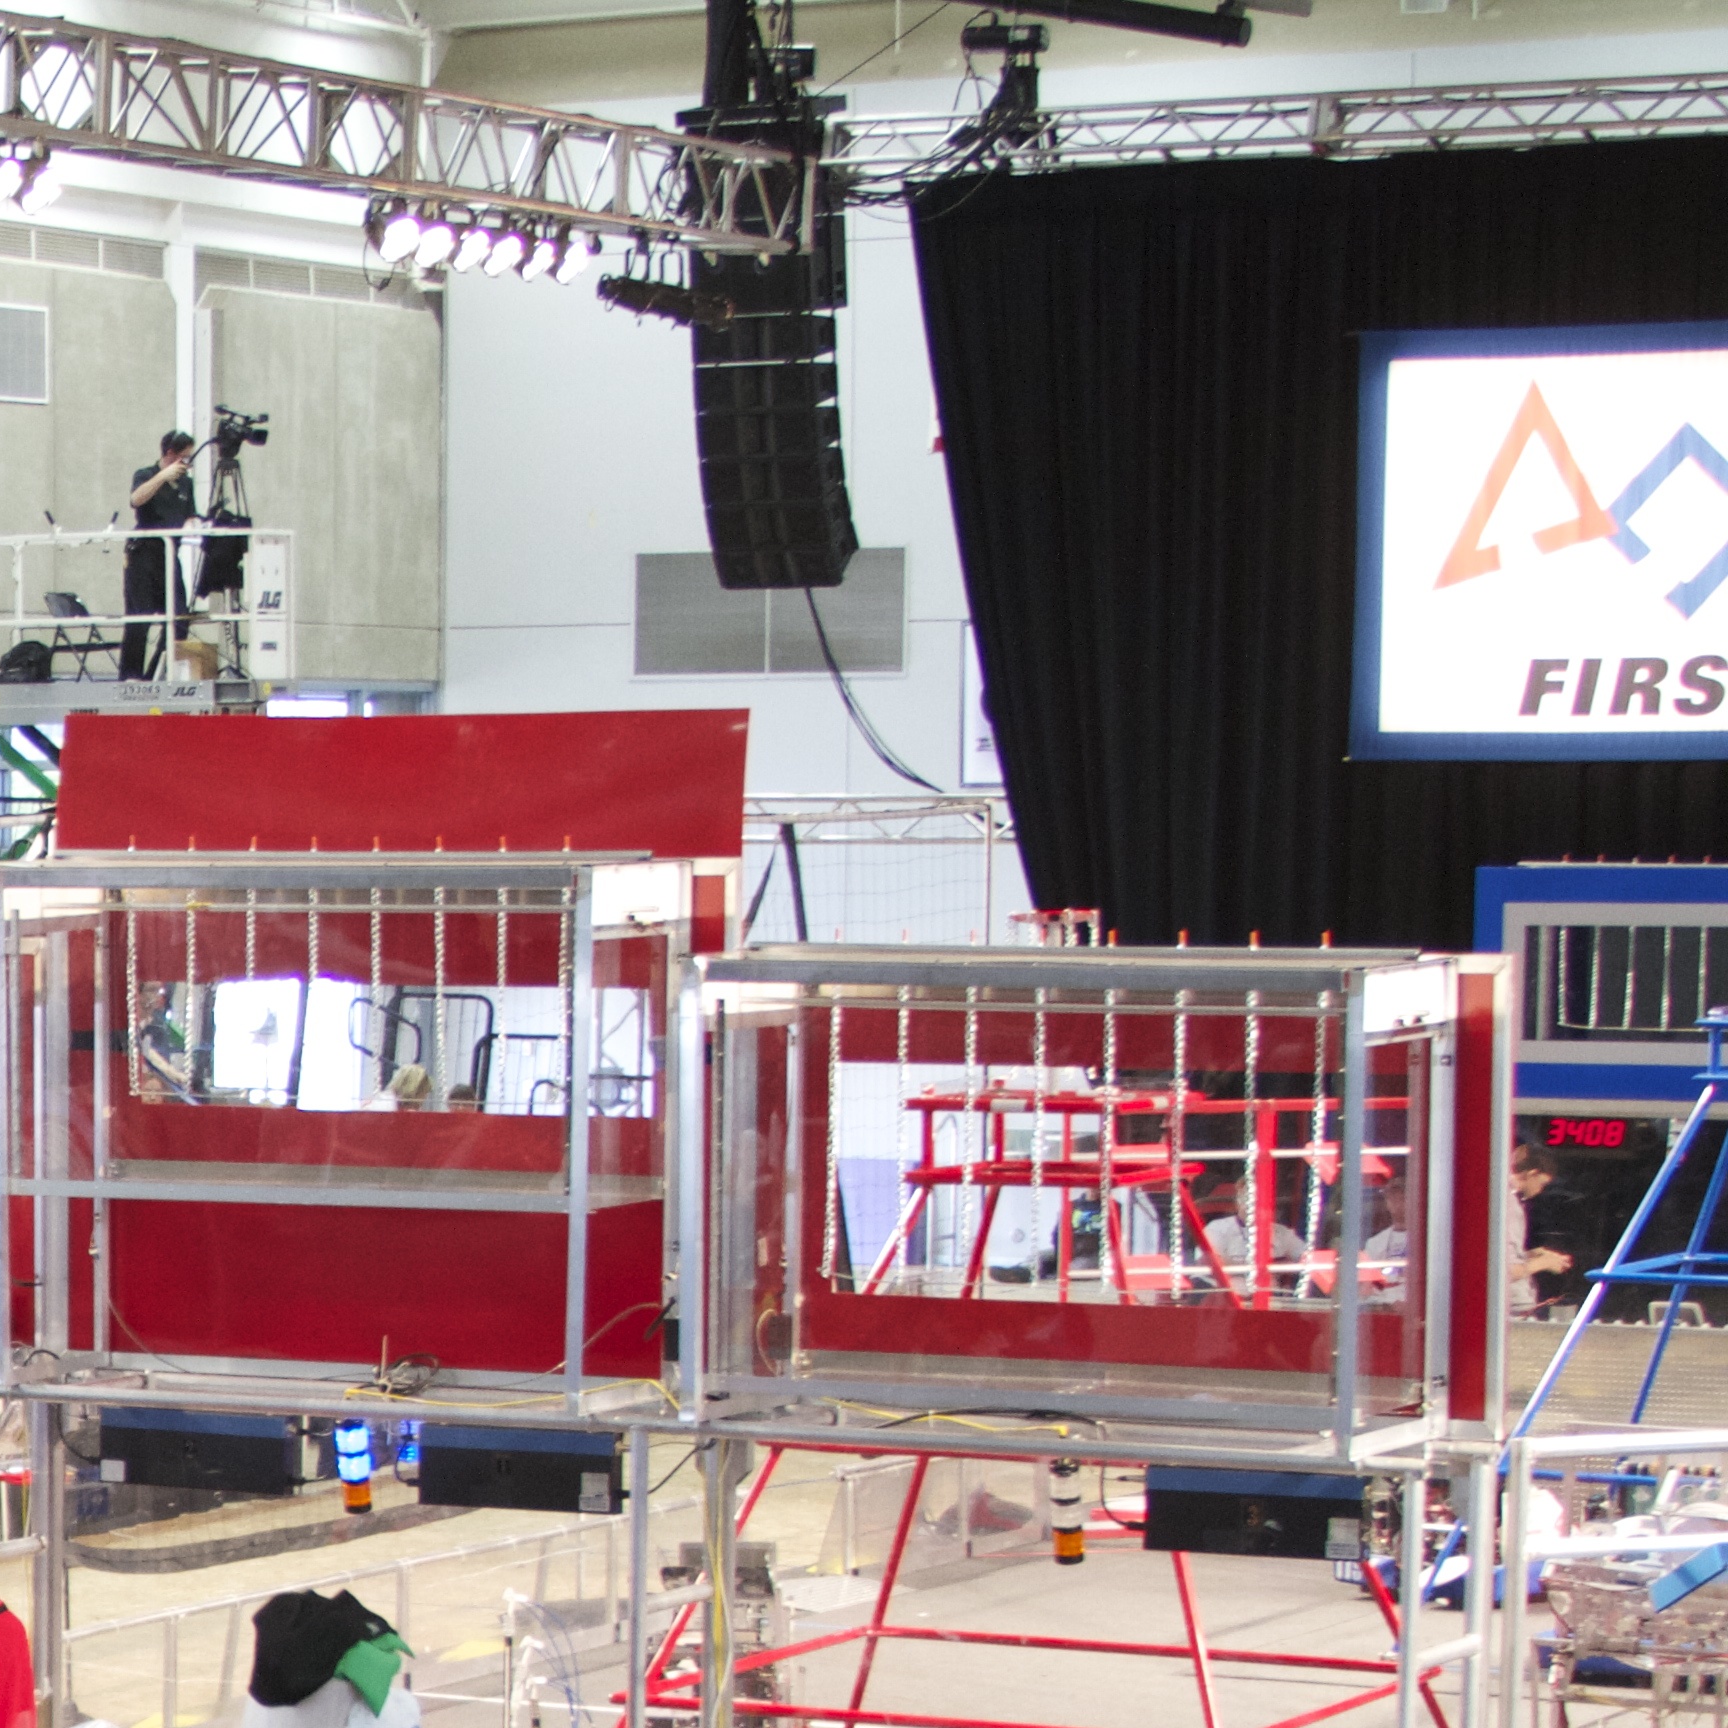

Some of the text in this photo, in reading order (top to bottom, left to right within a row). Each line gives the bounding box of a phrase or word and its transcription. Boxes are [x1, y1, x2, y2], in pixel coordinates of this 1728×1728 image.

[257, 591, 282, 609] JLG
[173, 686, 197, 697] JLG
[1518, 654, 1728, 716] FIRS
[1546, 1118, 1626, 1147] 3408
